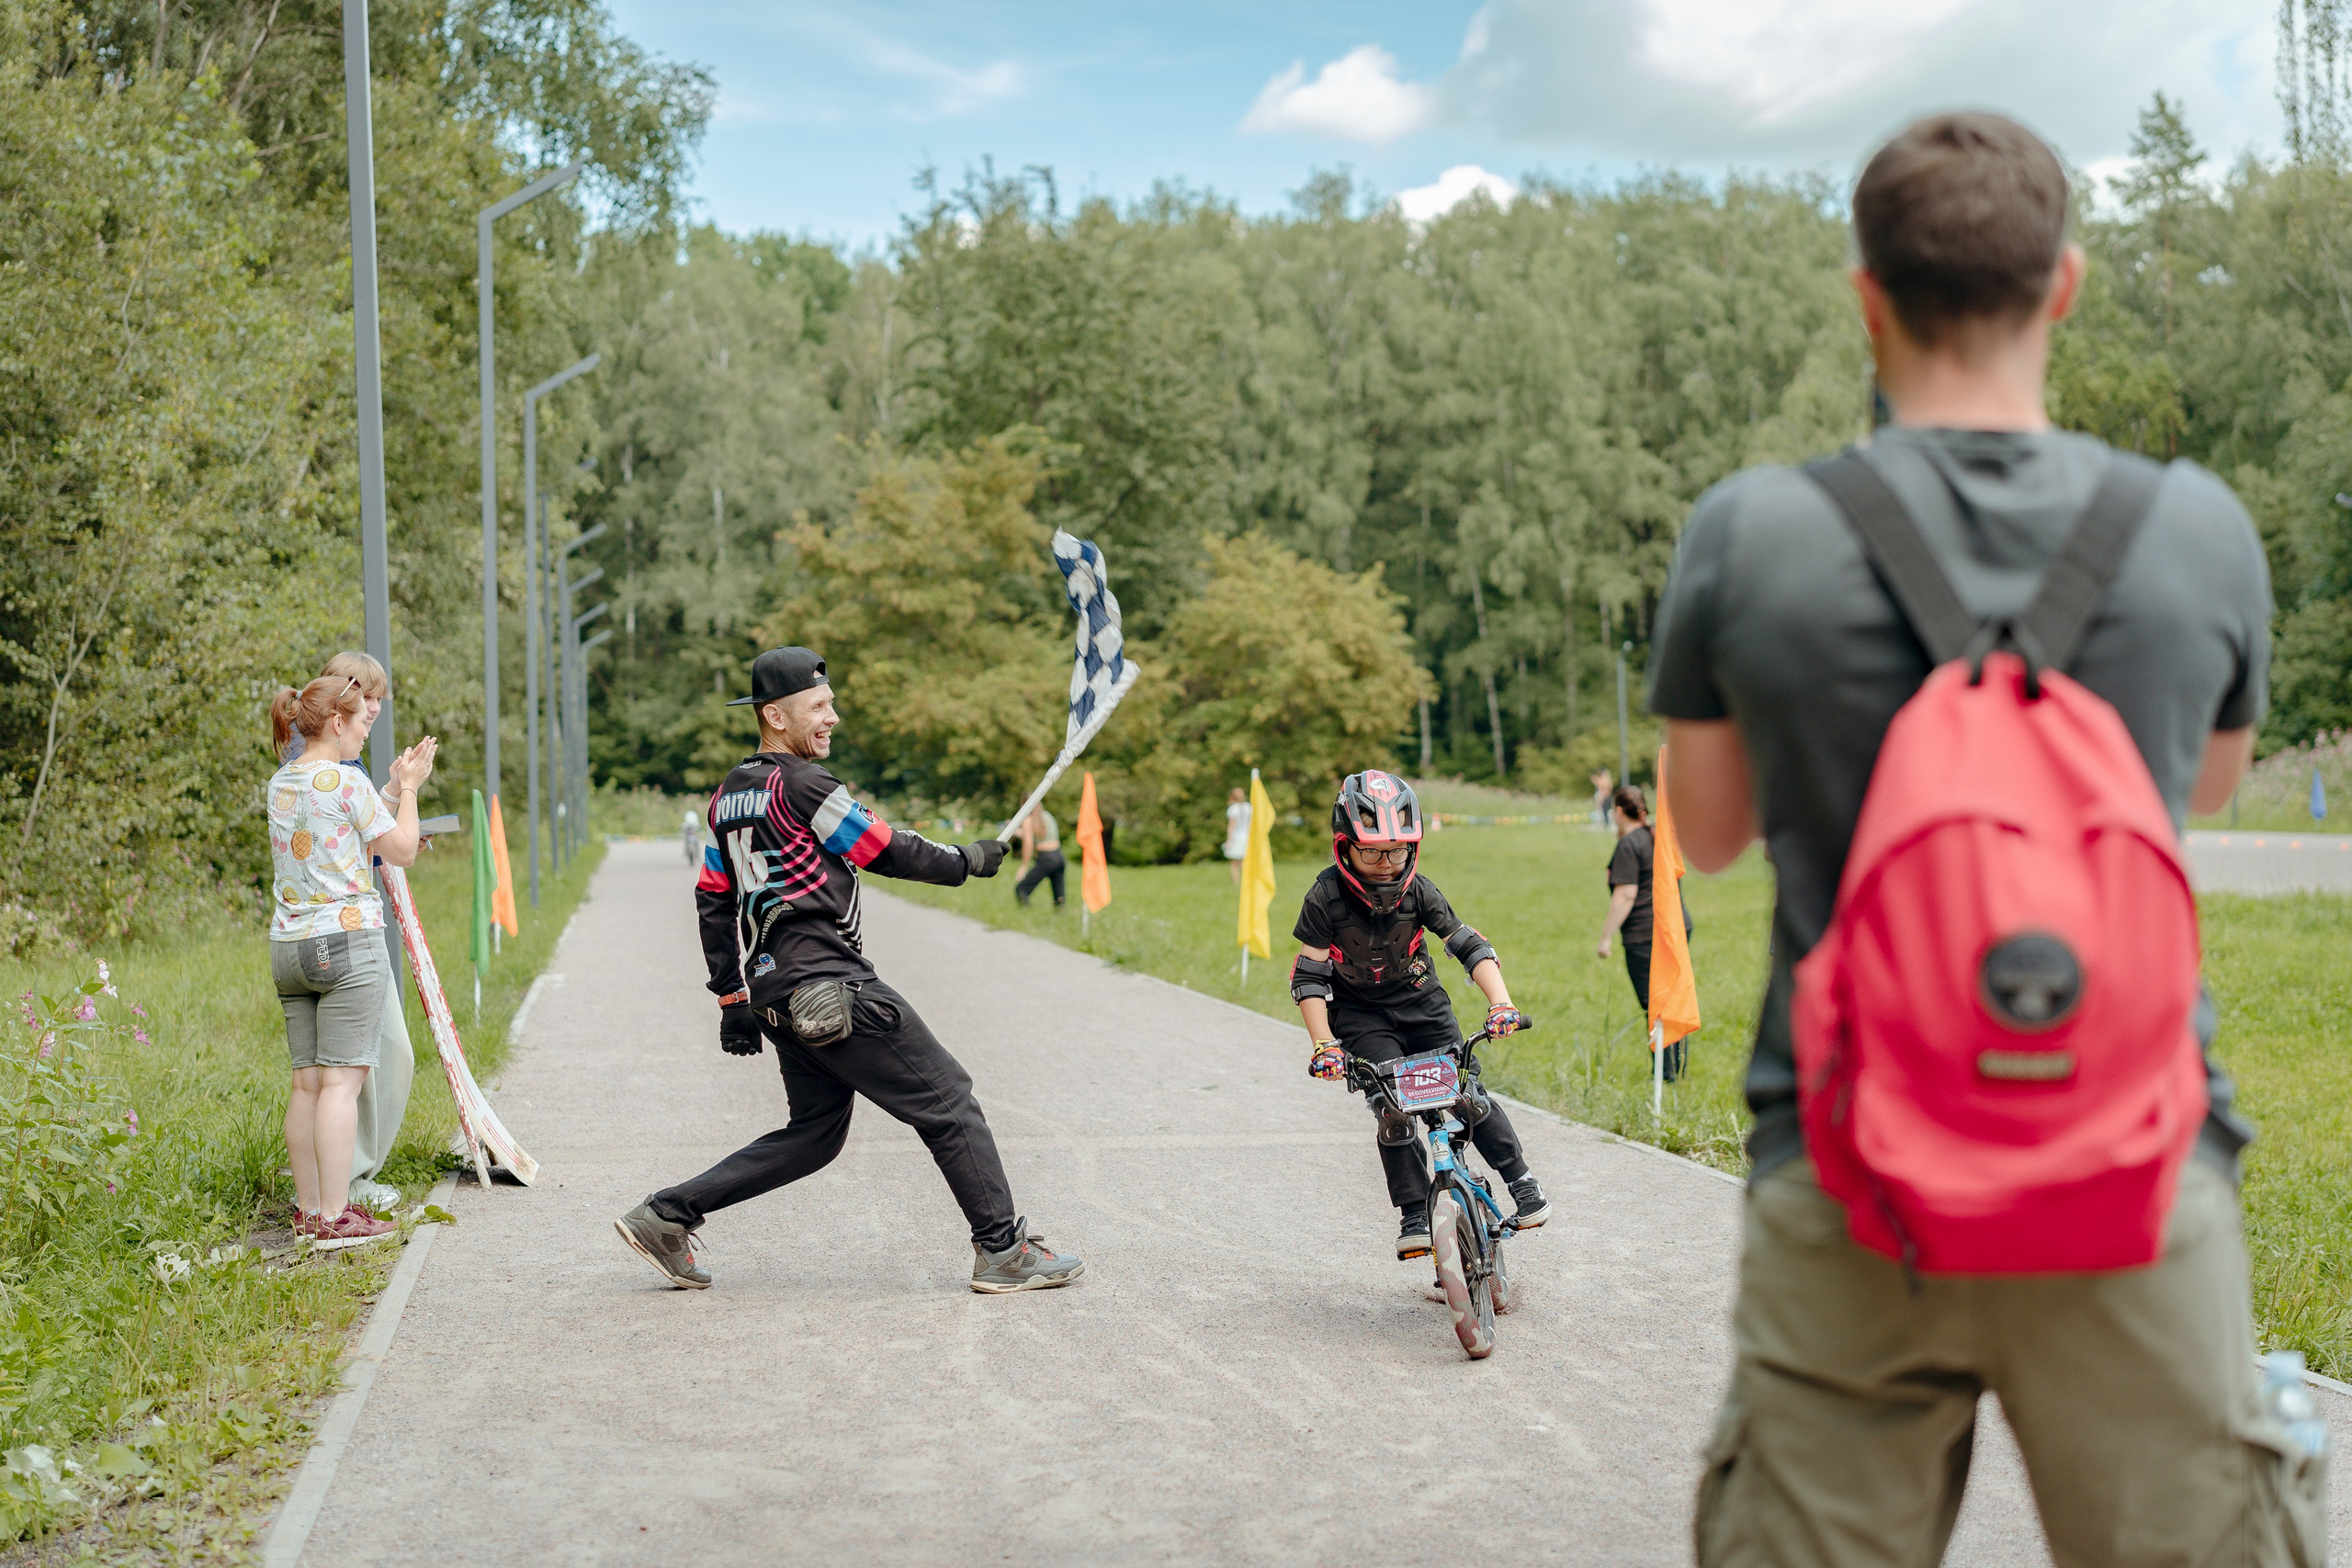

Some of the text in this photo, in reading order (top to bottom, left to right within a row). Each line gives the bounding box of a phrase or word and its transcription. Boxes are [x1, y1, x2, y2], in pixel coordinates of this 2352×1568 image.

[716, 788, 773, 826] VOITOV
[727, 827, 769, 896] 16
[1415, 975, 1429, 988] KITH
[1413, 1067, 1442, 1087] 103
